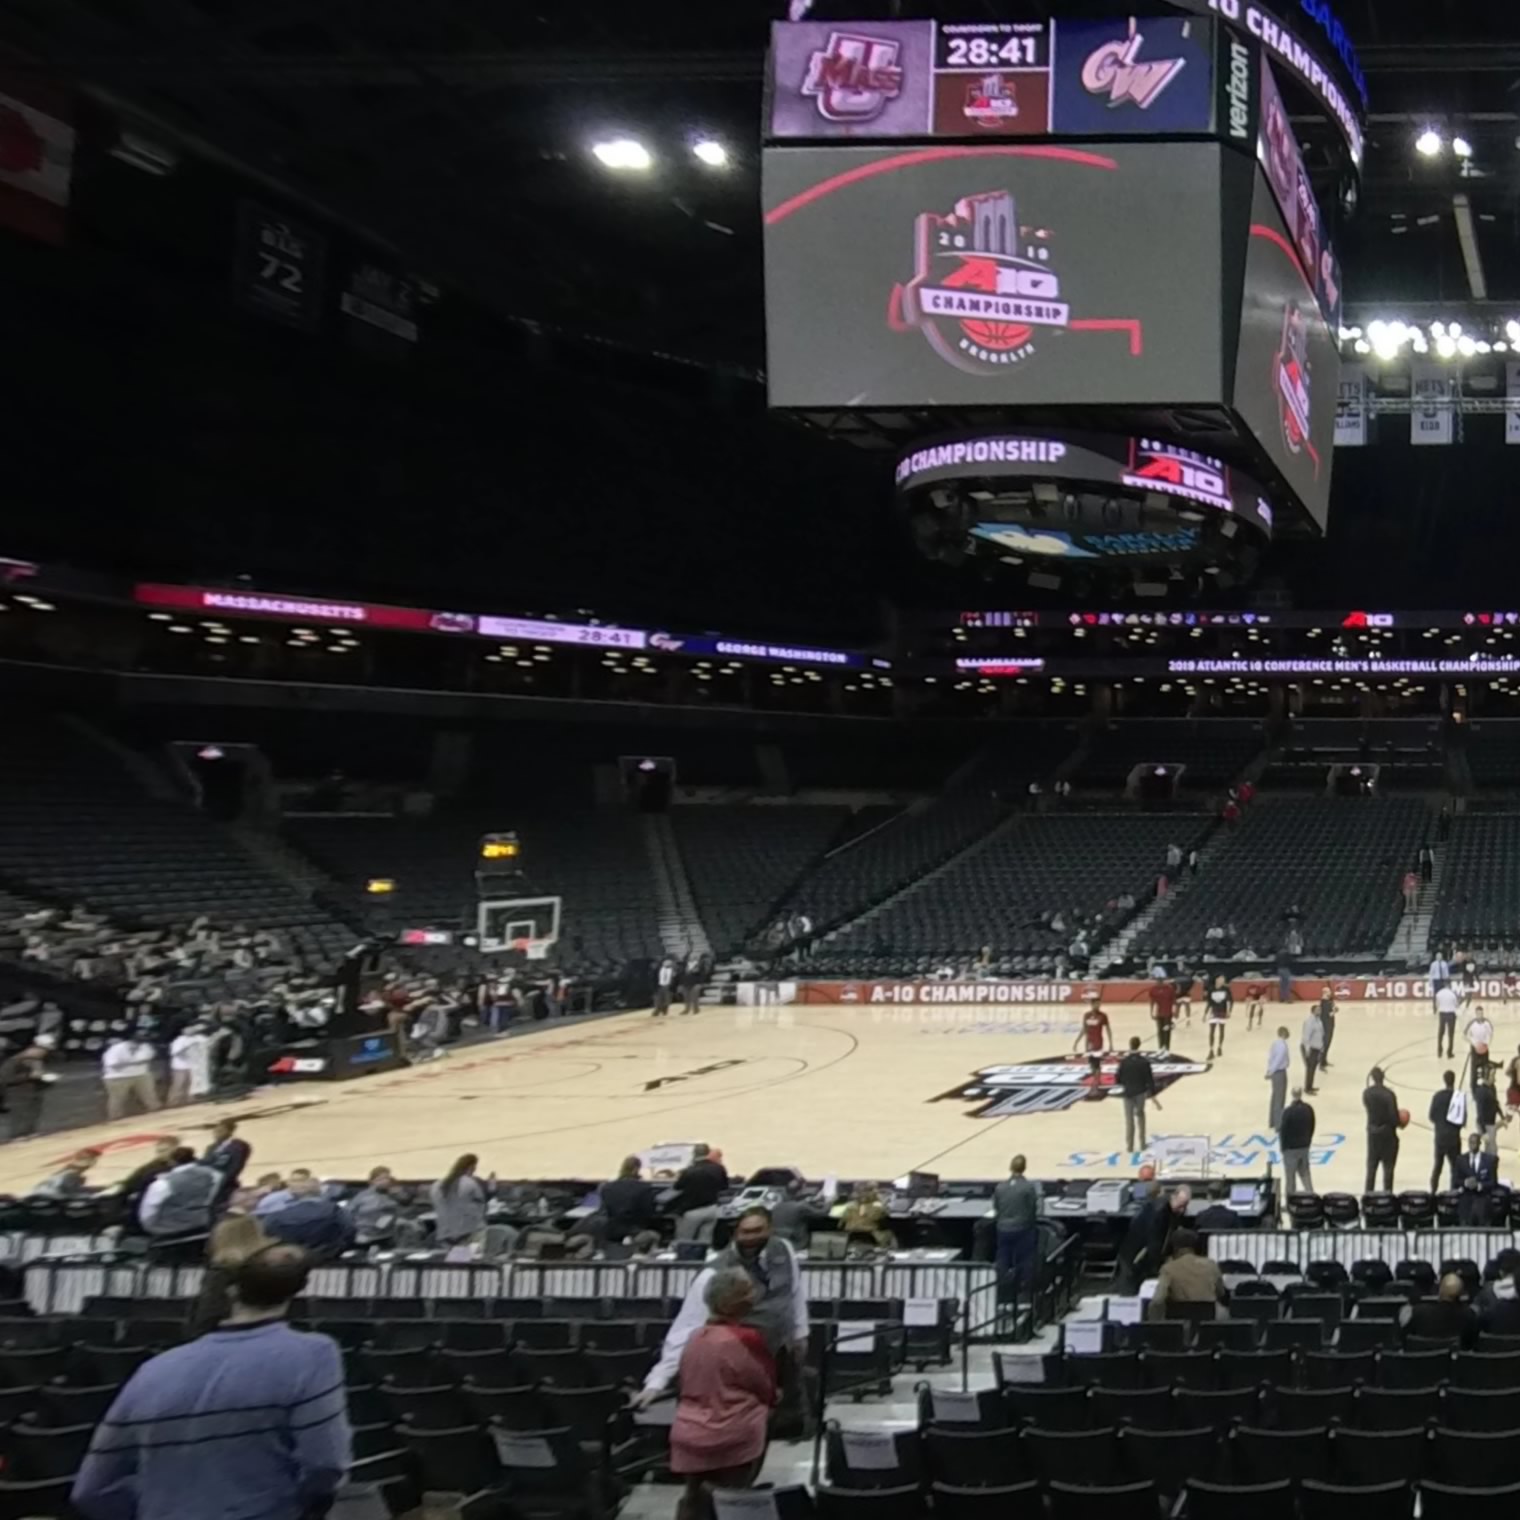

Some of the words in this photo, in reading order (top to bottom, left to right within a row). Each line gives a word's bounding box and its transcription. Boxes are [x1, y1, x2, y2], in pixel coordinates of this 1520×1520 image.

[947, 37, 1035, 64] 28:41
[1081, 33, 1187, 109] GW
[1225, 42, 1249, 139] verizon
[938, 231, 967, 249] 20
[942, 255, 1060, 300] A10
[931, 294, 1062, 320] CHAMPIONSHIP
[958, 337, 1036, 364] BROOKLYN
[911, 439, 1067, 473] CHAMPIONSHIP
[1138, 455, 1224, 496] A10
[203, 593, 366, 620] MASSACHUSETTS
[1342, 611, 1393, 629] A10
[578, 629, 632, 645] 28:41
[716, 642, 767, 656] GEORGE
[768, 647, 848, 663] WASHINGTON
[1168, 660, 1195, 672] 2019
[1196, 660, 1248, 672] ATLANTIC
[1250, 660, 1262, 672] 10
[1264, 660, 1333, 672] CONFERENCE
[1335, 660, 1369, 672] MEN'S
[1371, 660, 1437, 672] BASKETBALL
[871, 986, 915, 1003] A-10
[919, 985, 1072, 1002] CHAMPIONSHIP
[1364, 981, 1409, 998] A-10
